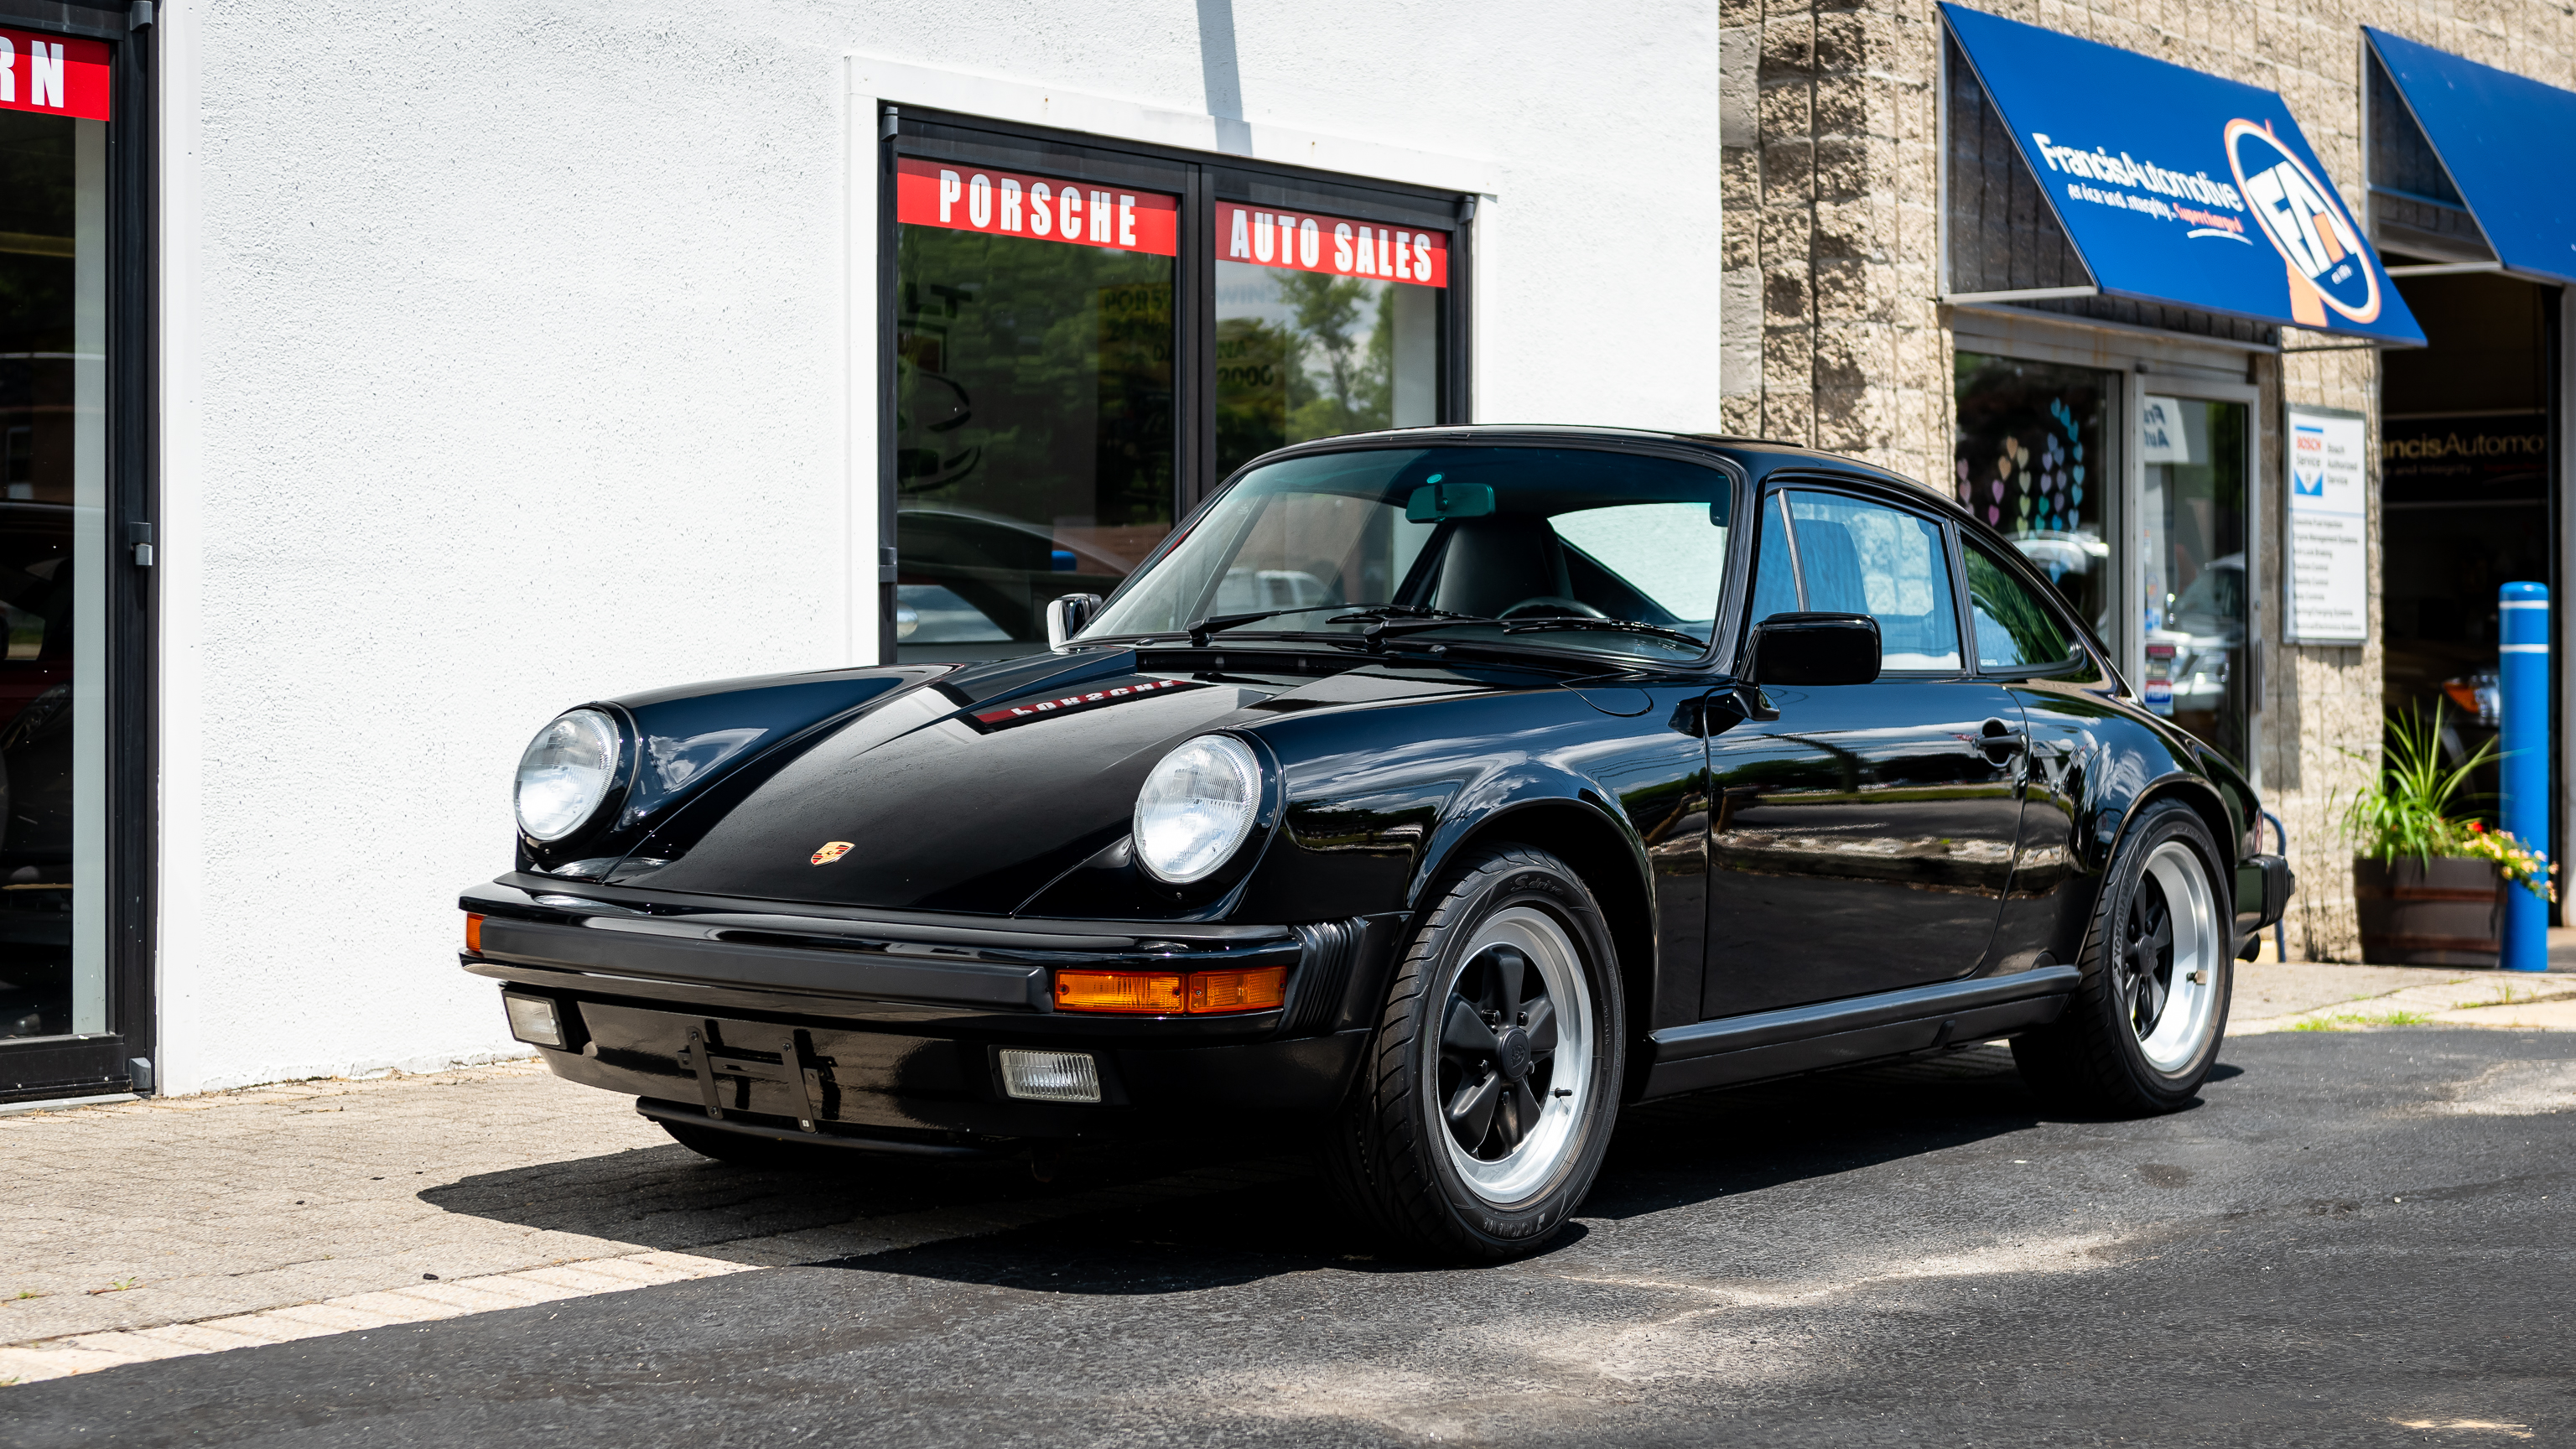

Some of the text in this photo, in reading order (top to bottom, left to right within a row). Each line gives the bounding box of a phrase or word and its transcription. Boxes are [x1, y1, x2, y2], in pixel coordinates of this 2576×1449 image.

[940, 169, 1136, 246] PORSCHE
[1229, 209, 1432, 282] AUTO SALES
[2297, 436, 2321, 451] BOSCH
[2297, 454, 2321, 467] Service
